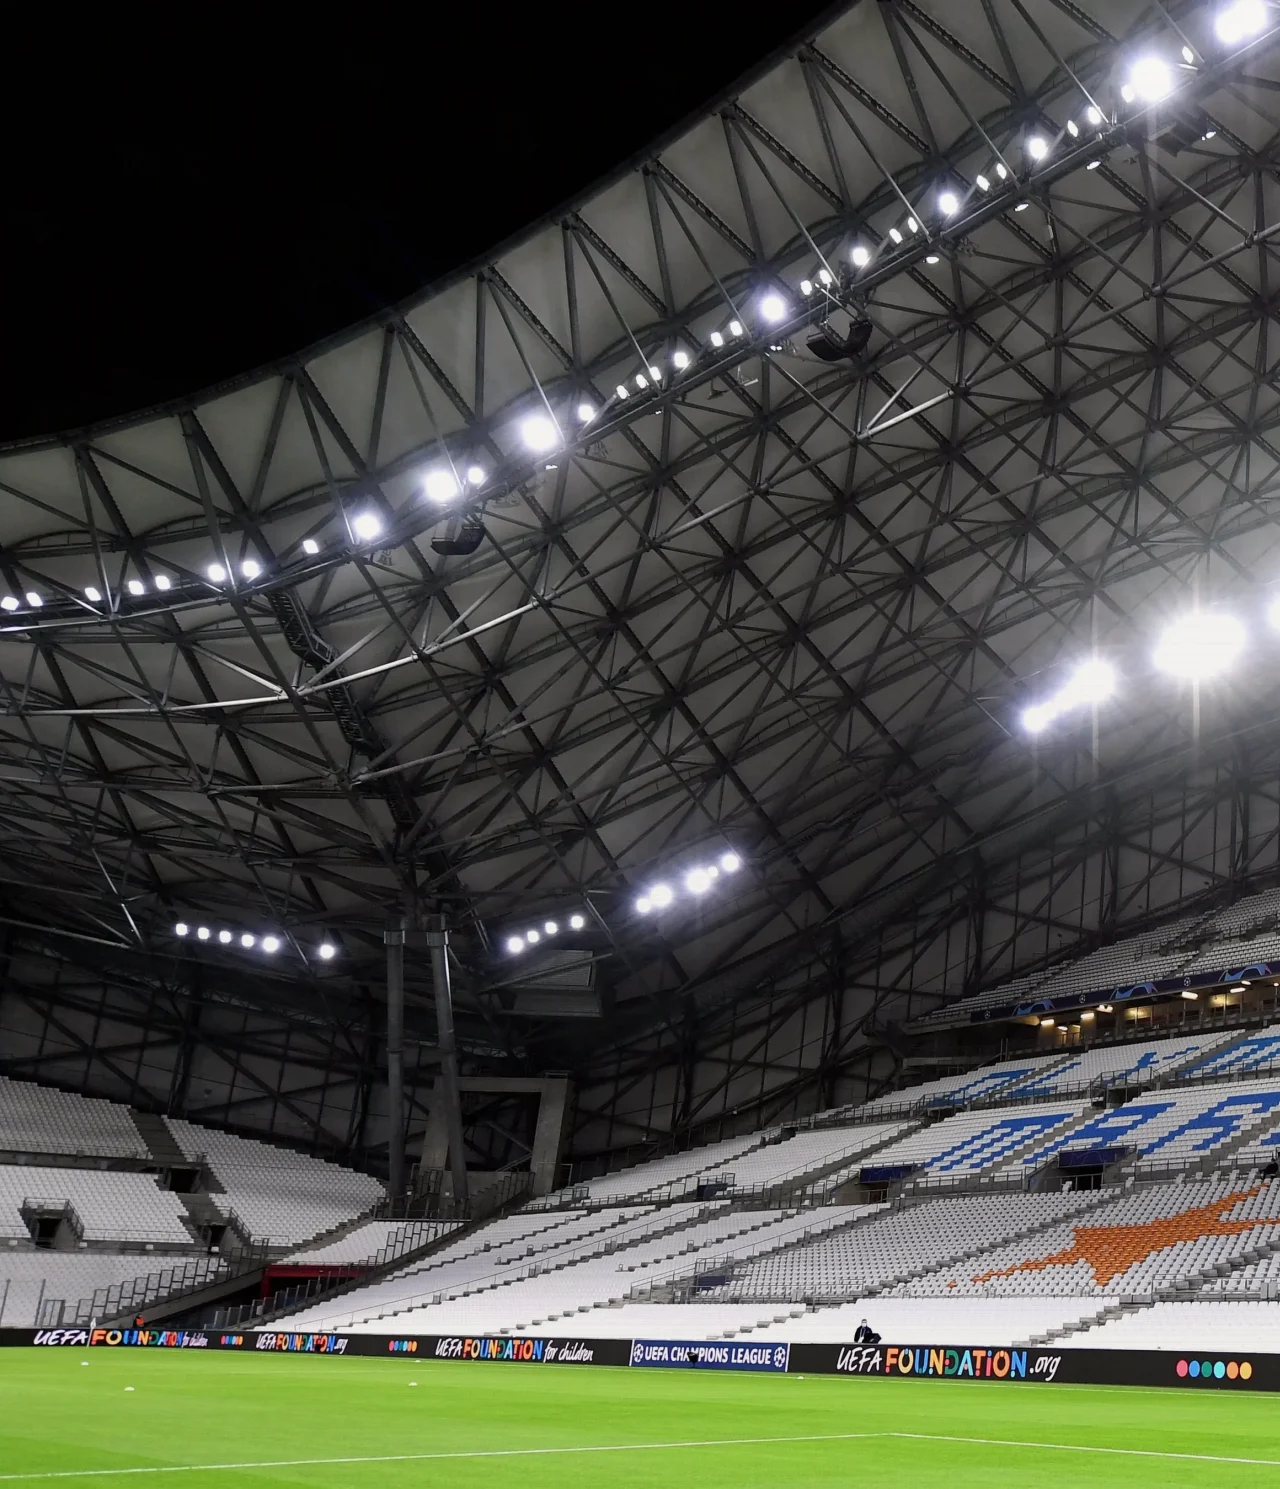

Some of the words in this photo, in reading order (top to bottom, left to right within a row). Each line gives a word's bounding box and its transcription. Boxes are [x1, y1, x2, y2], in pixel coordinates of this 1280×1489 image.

[33, 1329, 89, 1346] UEFA
[91, 1330, 183, 1346] FOUNDATION
[256, 1333, 277, 1349] UEFA
[435, 1338, 463, 1357] UEFA
[463, 1339, 543, 1360] FOUNDATION
[543, 1340, 556, 1363] for
[558, 1342, 593, 1362] children
[644, 1346, 669, 1361] UEFA
[731, 1348, 771, 1365] LEAGUE
[836, 1346, 882, 1373] UEFA
[885, 1348, 1027, 1378] FOUNDATION
